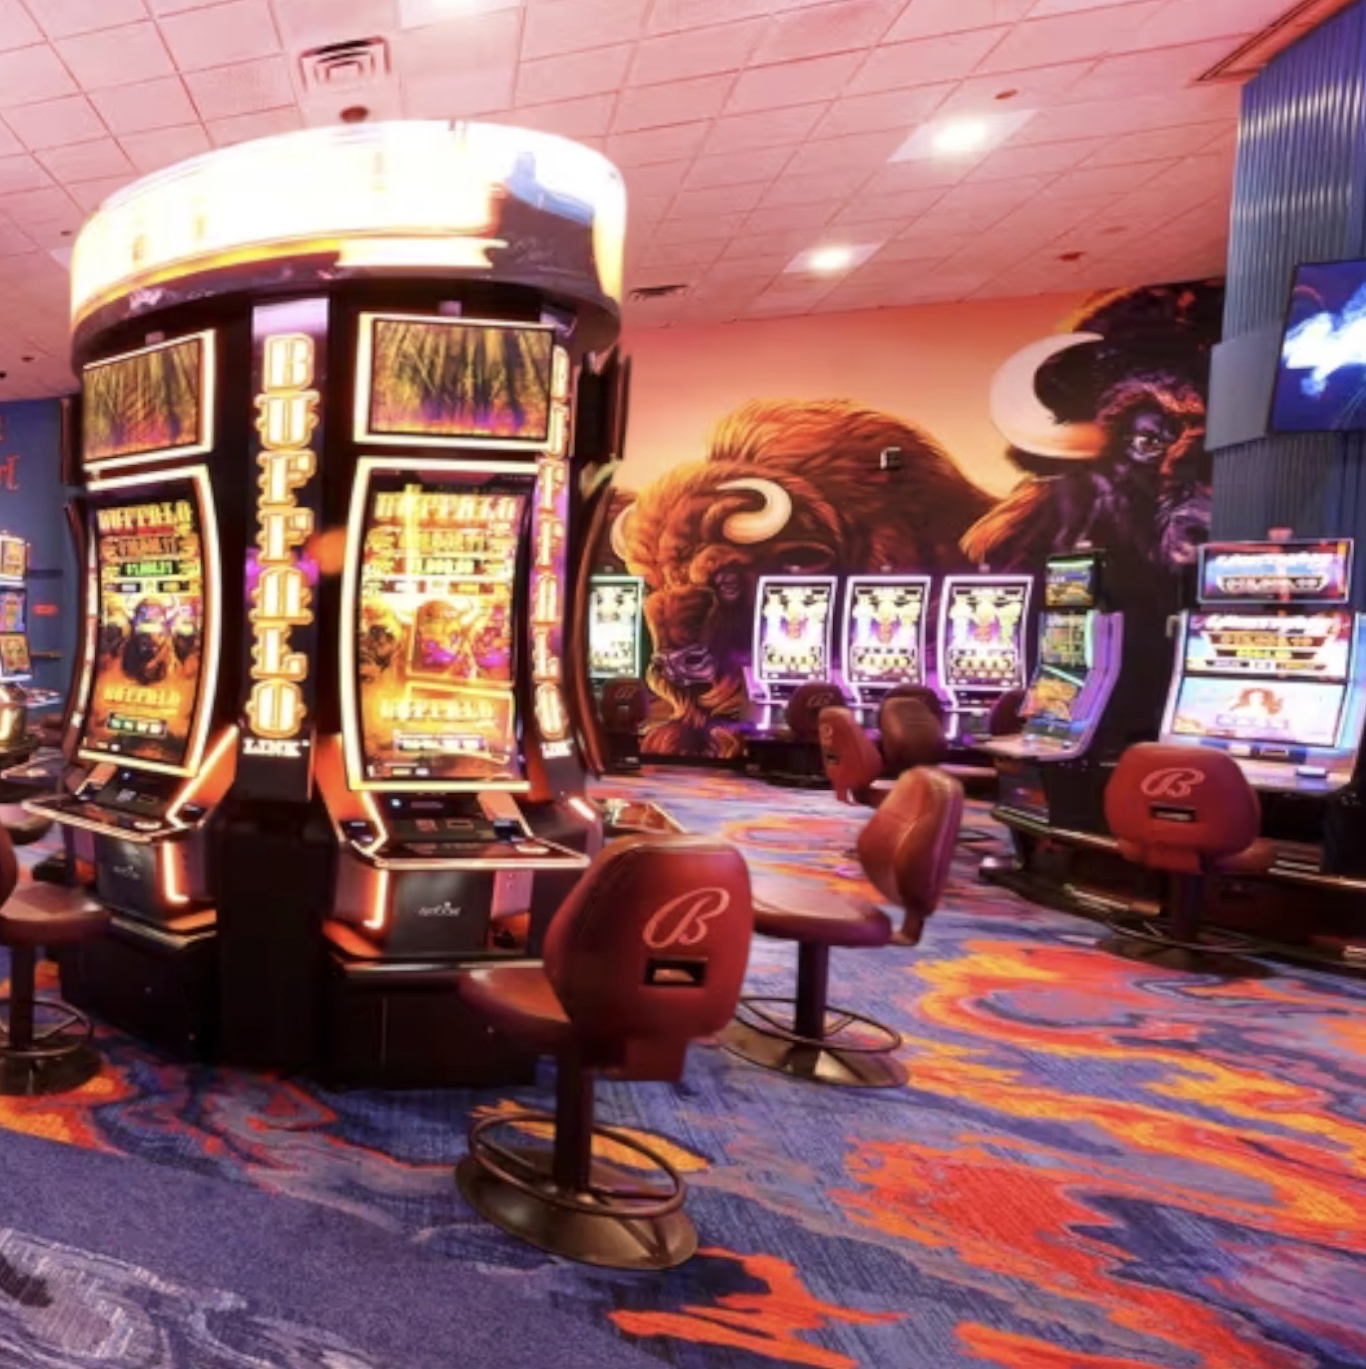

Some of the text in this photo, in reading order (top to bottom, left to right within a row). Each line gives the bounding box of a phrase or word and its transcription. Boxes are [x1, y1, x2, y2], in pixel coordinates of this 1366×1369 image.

[248, 332, 320, 738] BUFFALO
[1140, 767, 1206, 798] B
[642, 887, 731, 949] B
